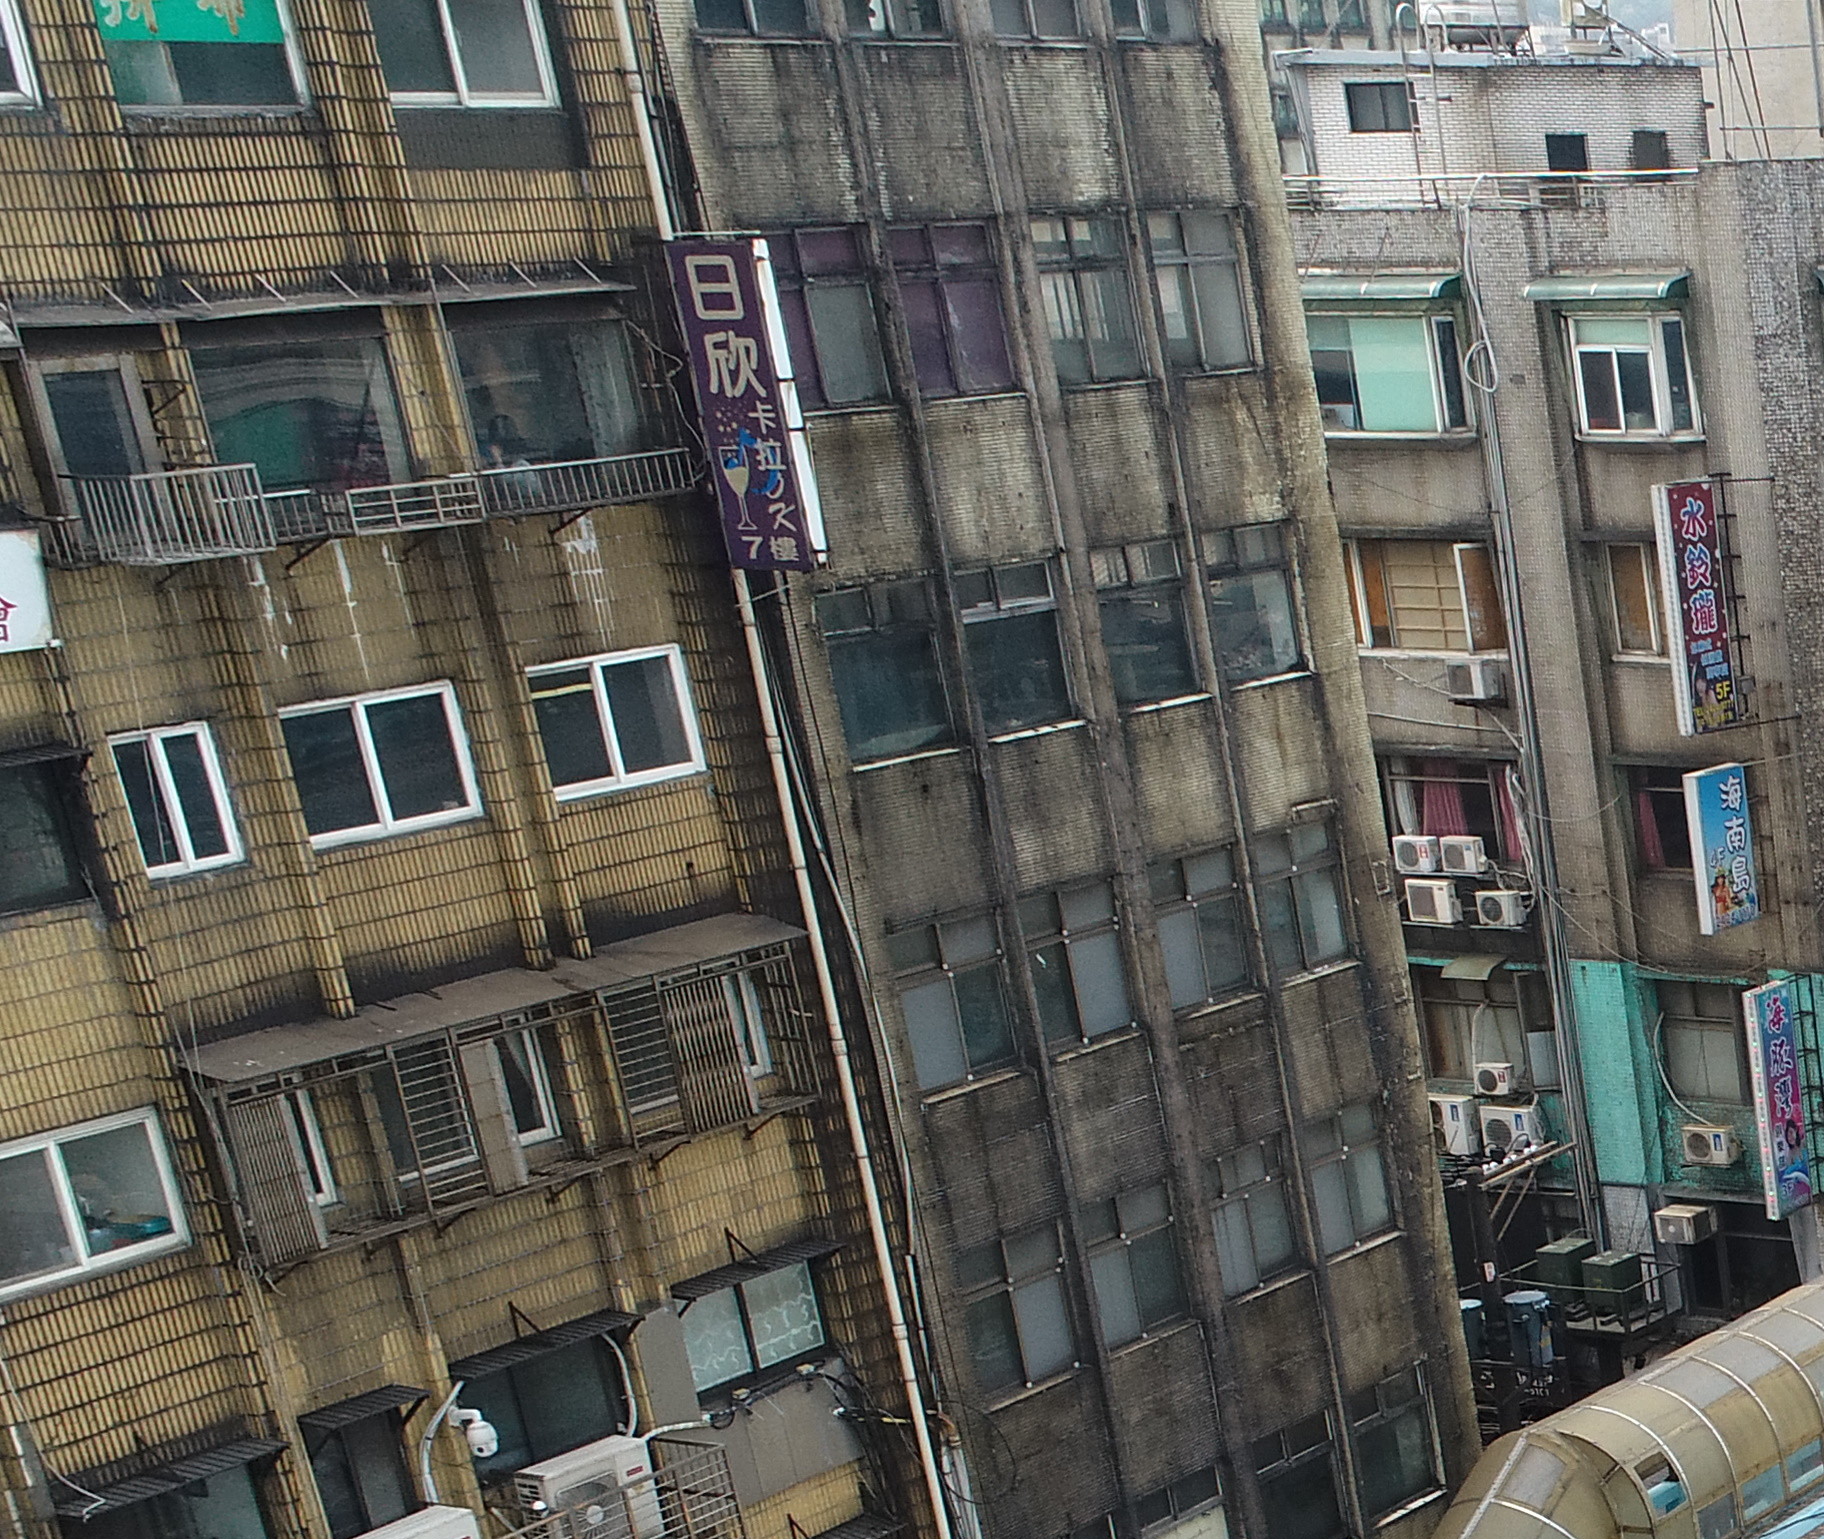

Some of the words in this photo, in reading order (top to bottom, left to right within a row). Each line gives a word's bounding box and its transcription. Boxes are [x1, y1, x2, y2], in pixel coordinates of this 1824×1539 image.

[685, 255, 766, 398] 日欣
[1715, 681, 1731, 699] 5F
[1719, 775, 1751, 893] 海南島
